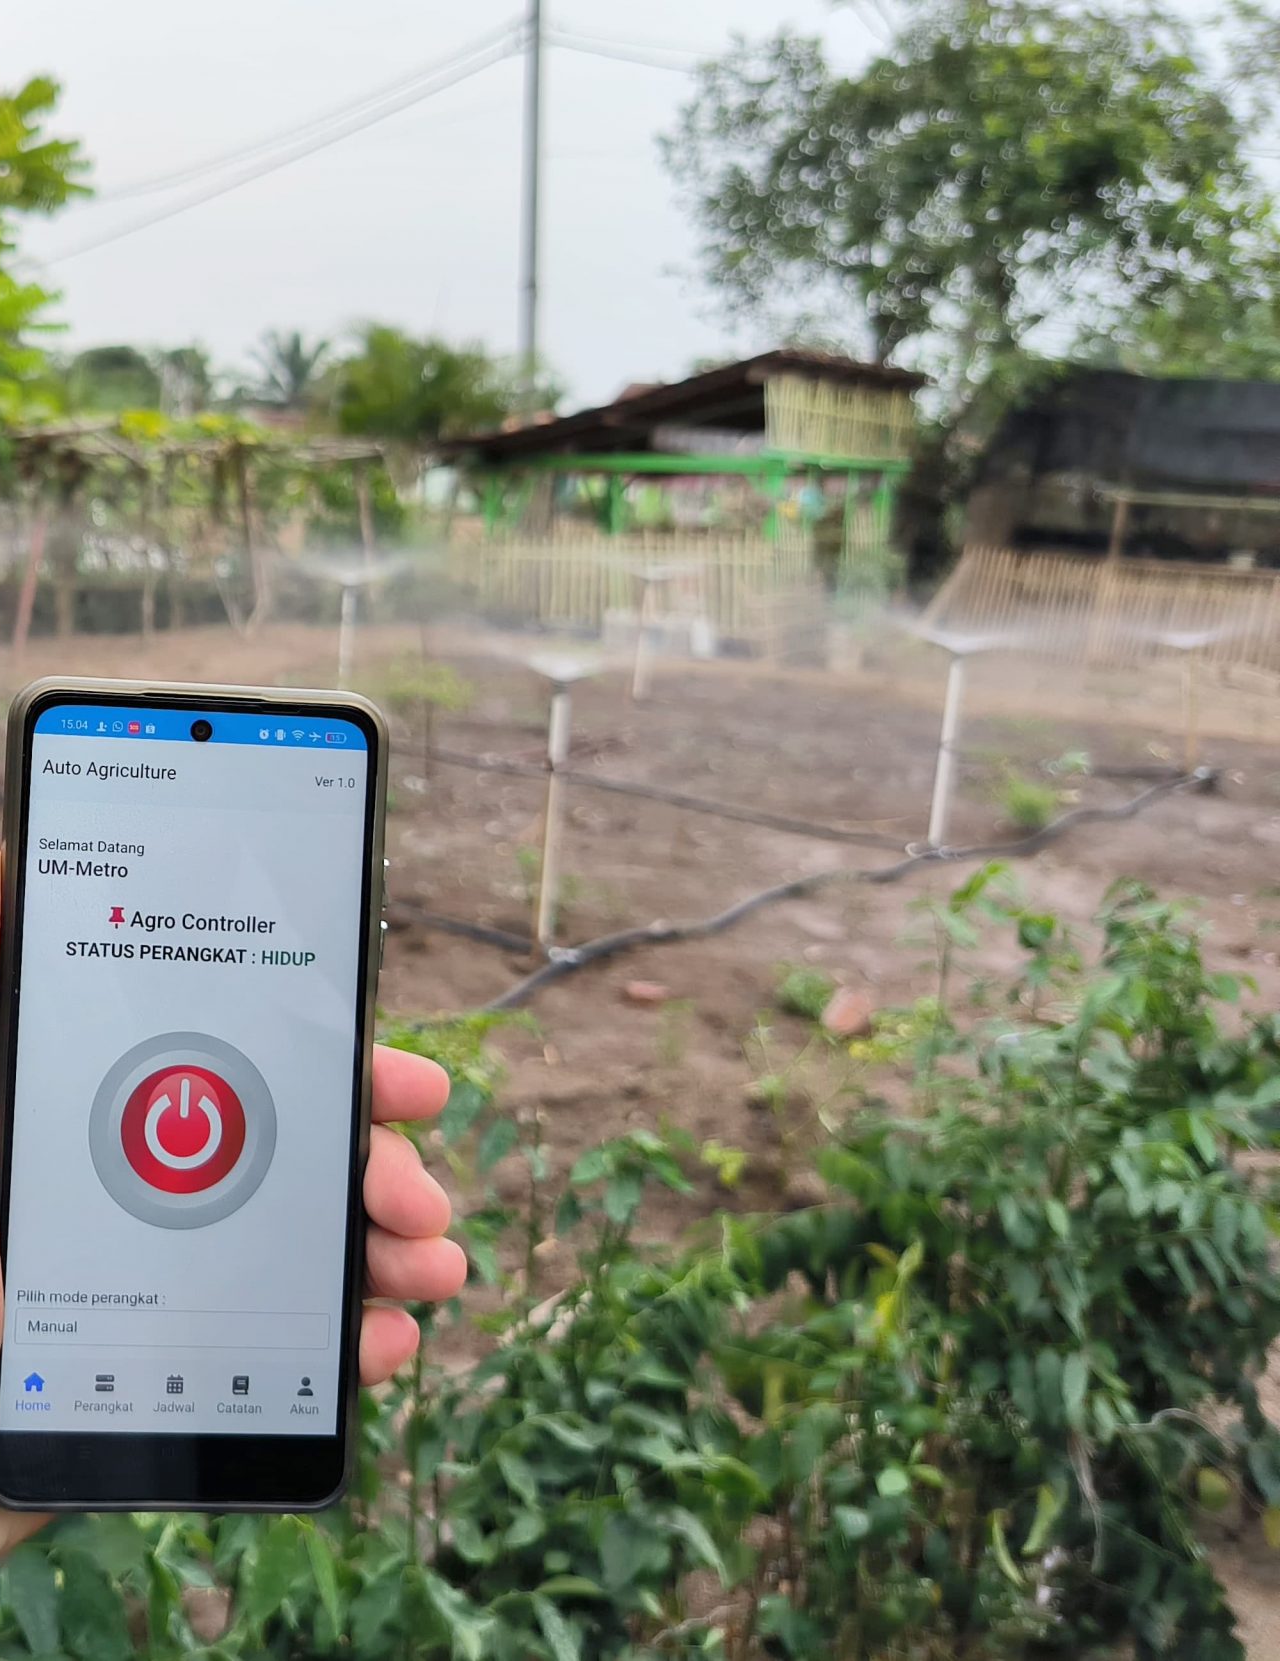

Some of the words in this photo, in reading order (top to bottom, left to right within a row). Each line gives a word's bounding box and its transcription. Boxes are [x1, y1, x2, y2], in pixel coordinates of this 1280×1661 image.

[61, 719, 88, 730] 15.04
[43, 760, 81, 775] Auto
[87, 762, 177, 780] Agriculture
[315, 777, 333, 788] Ver
[338, 778, 355, 788] 1.0
[39, 839, 93, 852] Selamat
[98, 841, 145, 856] Datang
[38, 859, 128, 878] UM-Metro
[131, 911, 176, 932] Agro
[182, 913, 276, 934] Controller
[66, 942, 134, 959] STATUS
[139, 945, 246, 964] PERANGKAT
[261, 950, 316, 966] HIDUP
[17, 1290, 45, 1303] Pilih
[50, 1292, 88, 1303] mode
[92, 1292, 158, 1306] perangkat
[28, 1320, 77, 1333] Manual
[16, 1400, 51, 1411] Home
[74, 1400, 133, 1414] Perangkat
[153, 1402, 195, 1413] Jadwal
[217, 1403, 262, 1414] Catatan
[290, 1403, 319, 1415] Akun
